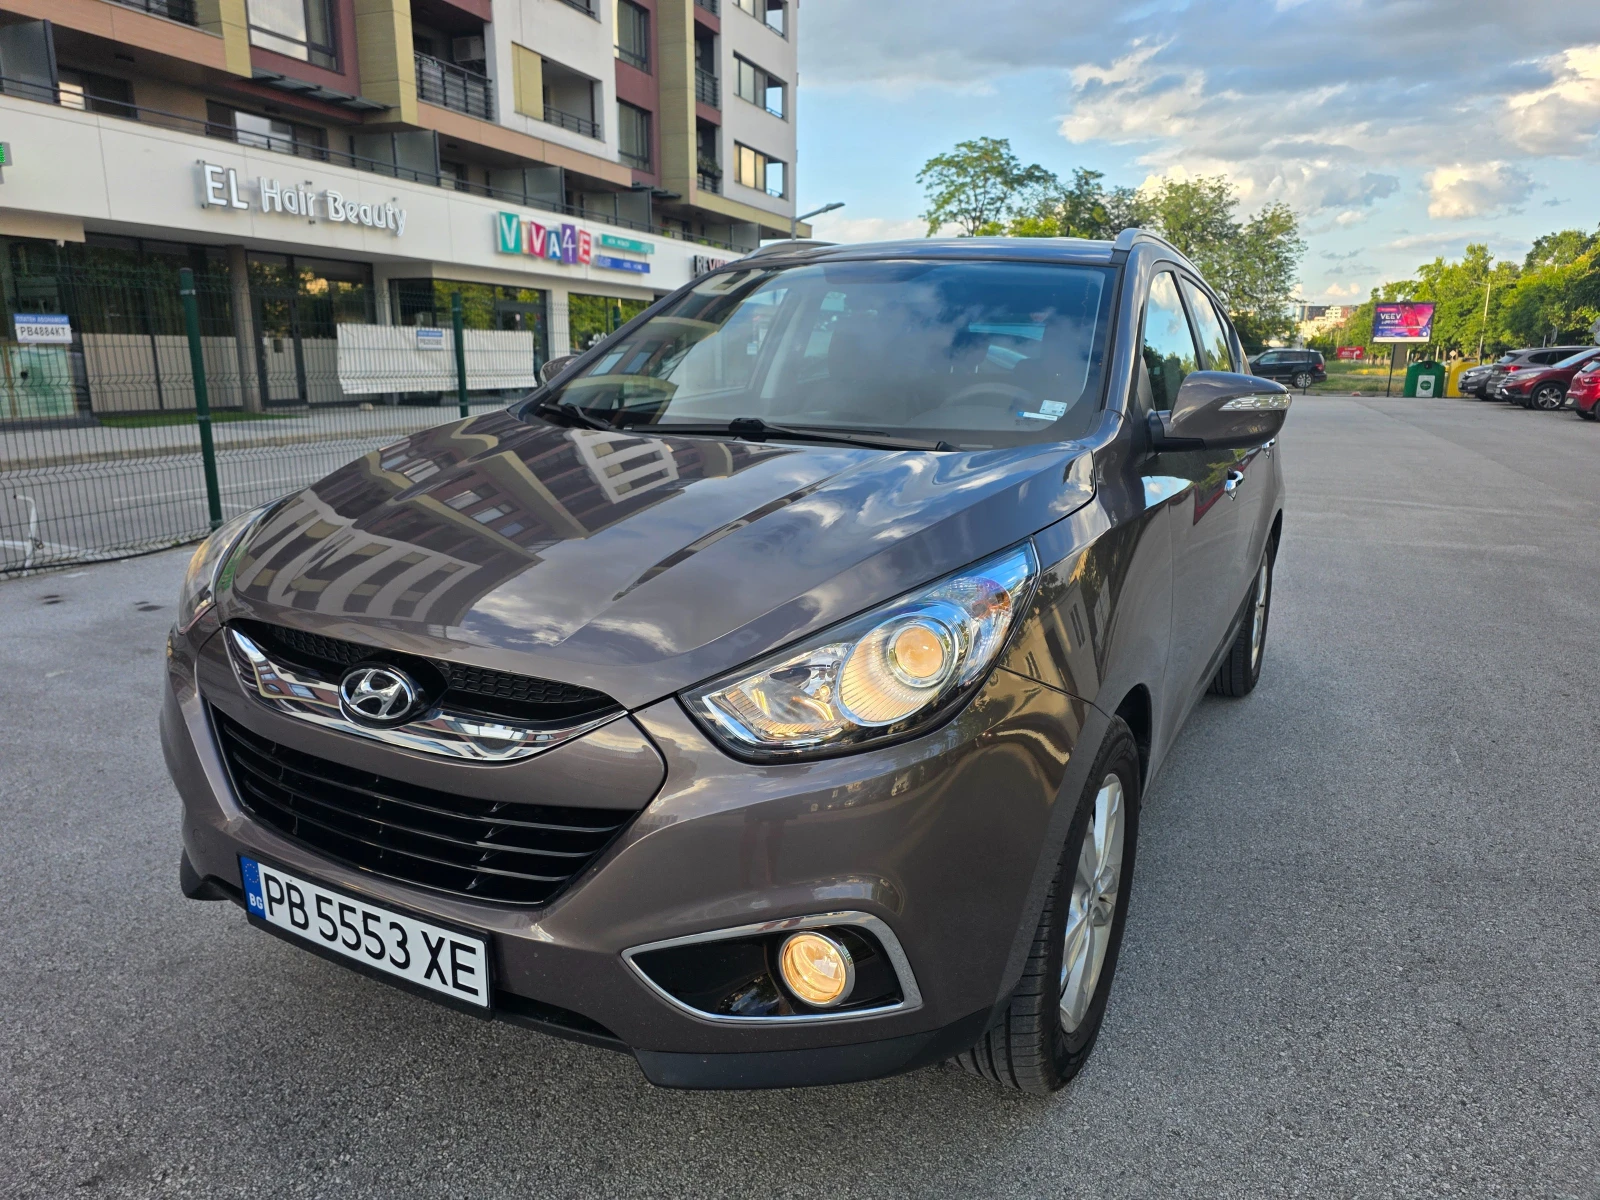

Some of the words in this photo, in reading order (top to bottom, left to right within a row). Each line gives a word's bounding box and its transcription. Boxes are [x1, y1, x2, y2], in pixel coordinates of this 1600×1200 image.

[203, 163, 248, 210] EL
[258, 176, 316, 218] Hair
[324, 188, 407, 237] Beauty
[500, 213, 591, 264] VIVA4E
[248, 892, 264, 910] BG
[263, 872, 310, 931] PB
[315, 893, 411, 970] 5553
[421, 929, 479, 997] XE
